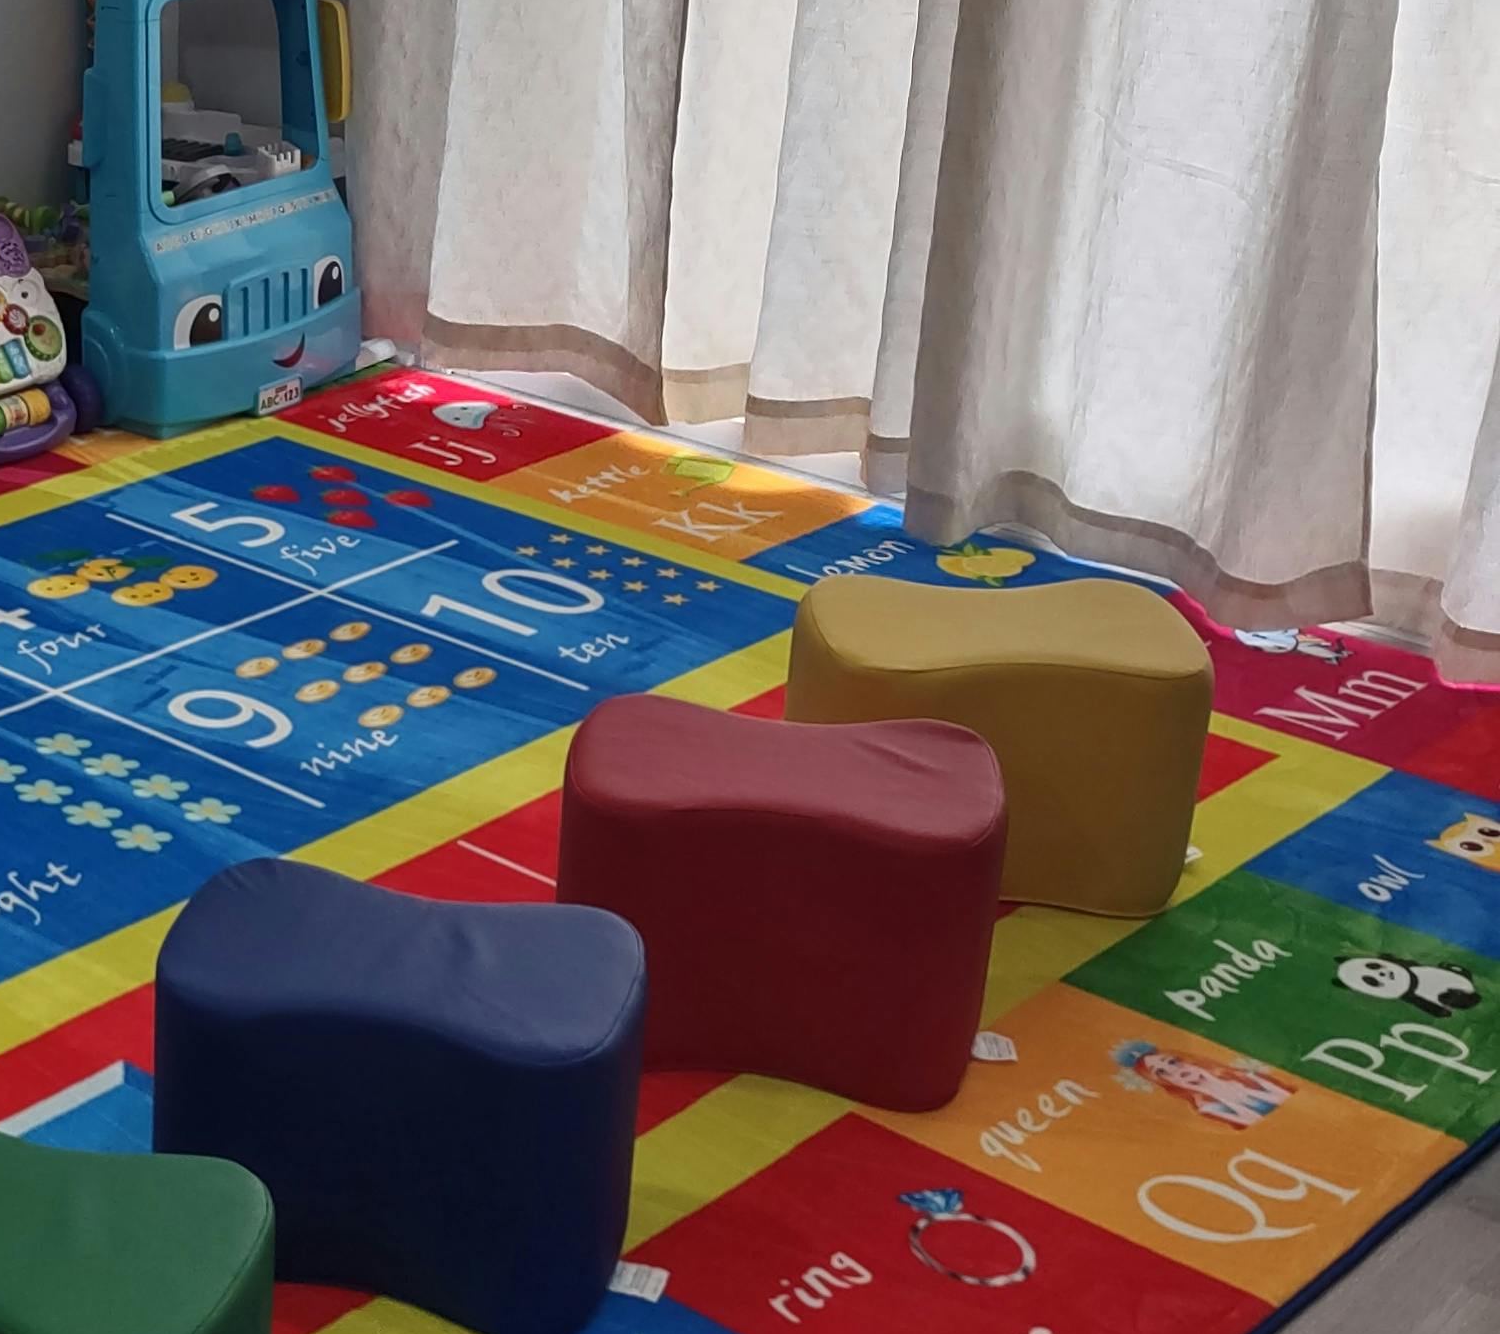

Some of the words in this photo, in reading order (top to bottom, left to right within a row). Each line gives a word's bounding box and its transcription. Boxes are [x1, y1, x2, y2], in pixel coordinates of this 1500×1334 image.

[319, 381, 436, 433] jellyfish
[411, 436, 496, 465] Jj
[549, 465, 645, 502] kettle
[171, 502, 287, 549] 5
[651, 501, 784, 543] Kk
[279, 532, 361, 576] five
[421, 569, 606, 637] 10
[16, 620, 109, 675] four
[558, 630, 630, 667] ten
[167, 689, 294, 749] 9
[1256, 671, 1426, 739] Mm
[300, 724, 398, 777] nine
[1358, 855, 1424, 901] owl
[1165, 940, 1291, 1020] panda
[1302, 1023, 1495, 1101] Pp
[980, 1080, 1097, 1172] queen
[1137, 1149, 1358, 1242] Qq
[770, 1252, 872, 1322] ring
